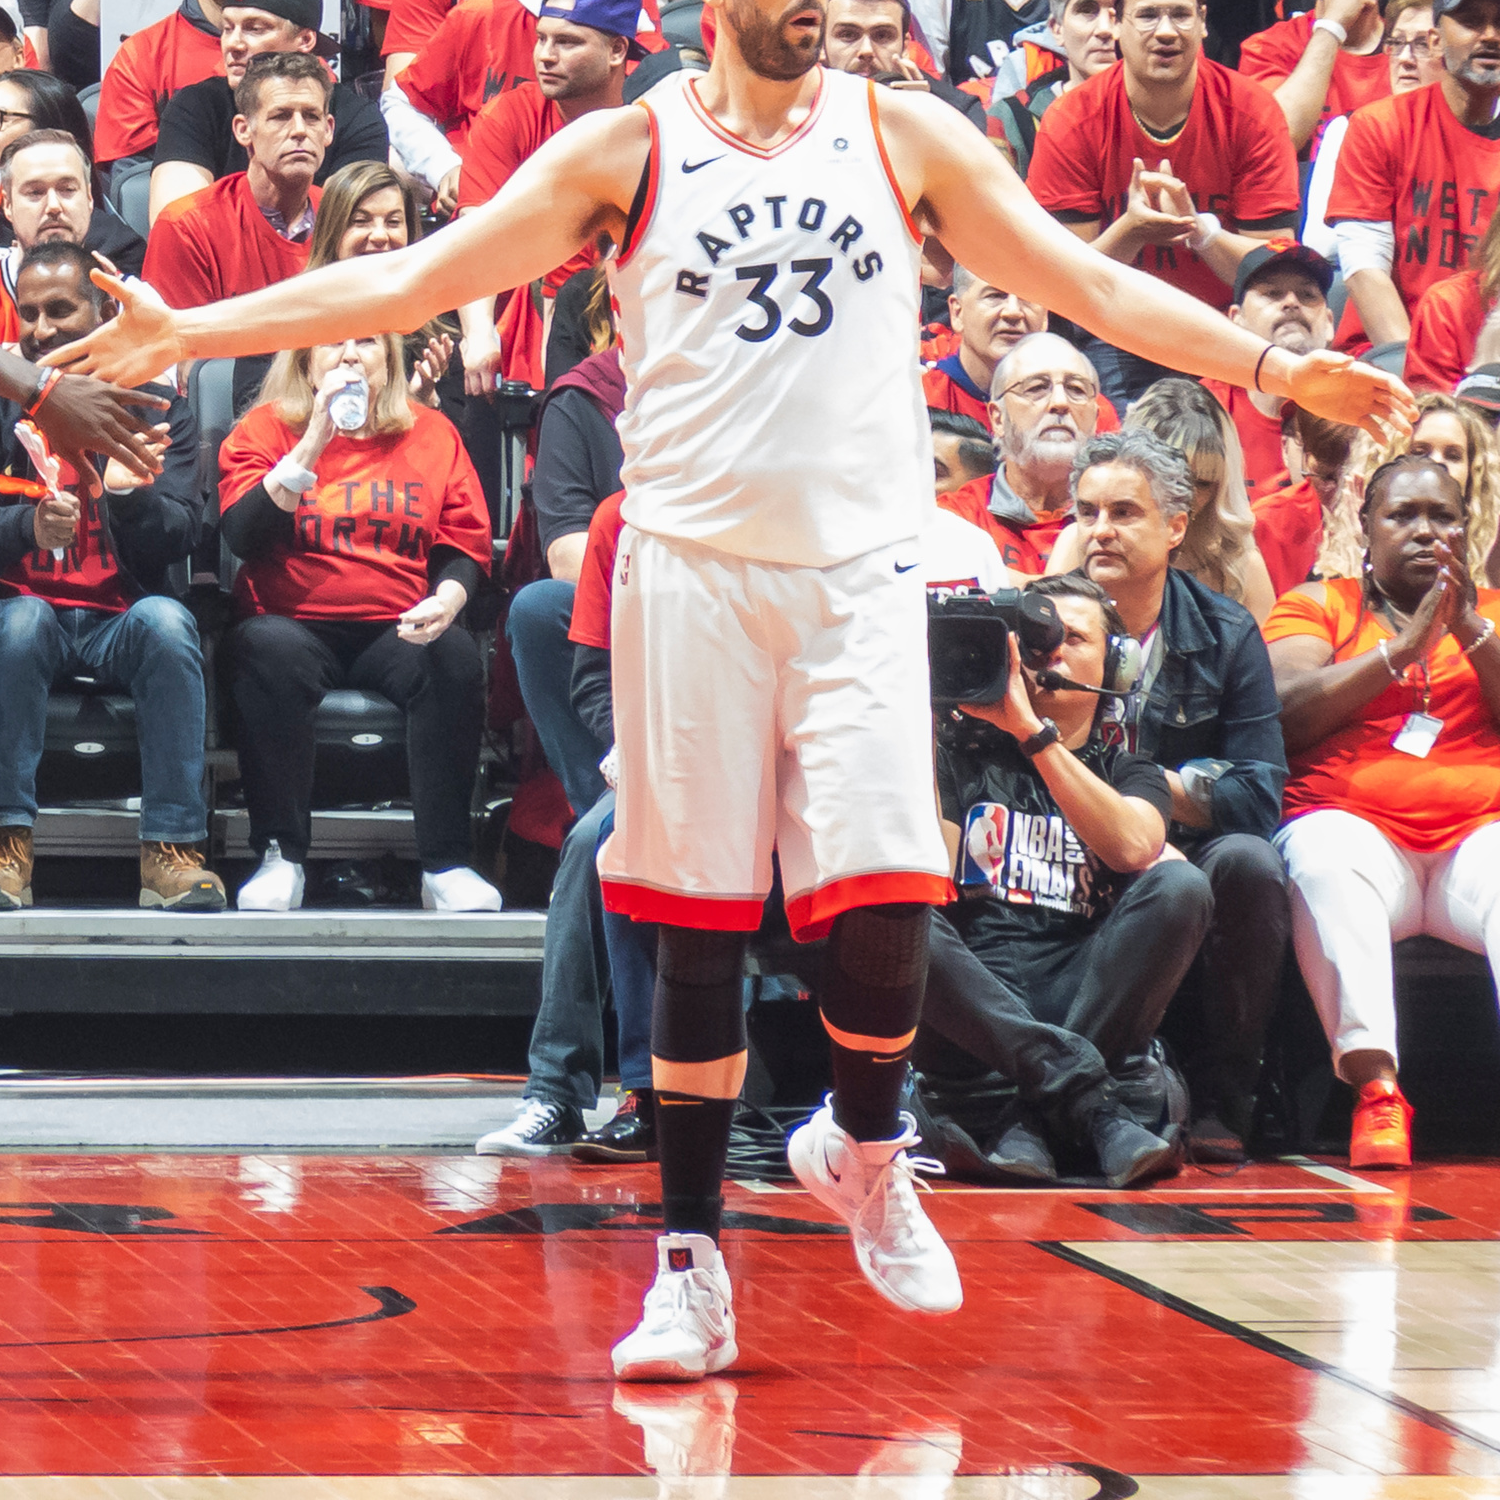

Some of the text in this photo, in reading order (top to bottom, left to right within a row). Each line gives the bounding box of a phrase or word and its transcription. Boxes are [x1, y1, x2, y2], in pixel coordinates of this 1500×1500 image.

[676, 195, 883, 299] RAPTORS
[735, 258, 834, 343] 33
[338, 478, 425, 518] THE
[299, 510, 427, 557] ORTH
[1011, 811, 1064, 862] NBA
[1007, 854, 1095, 902] FINALS
